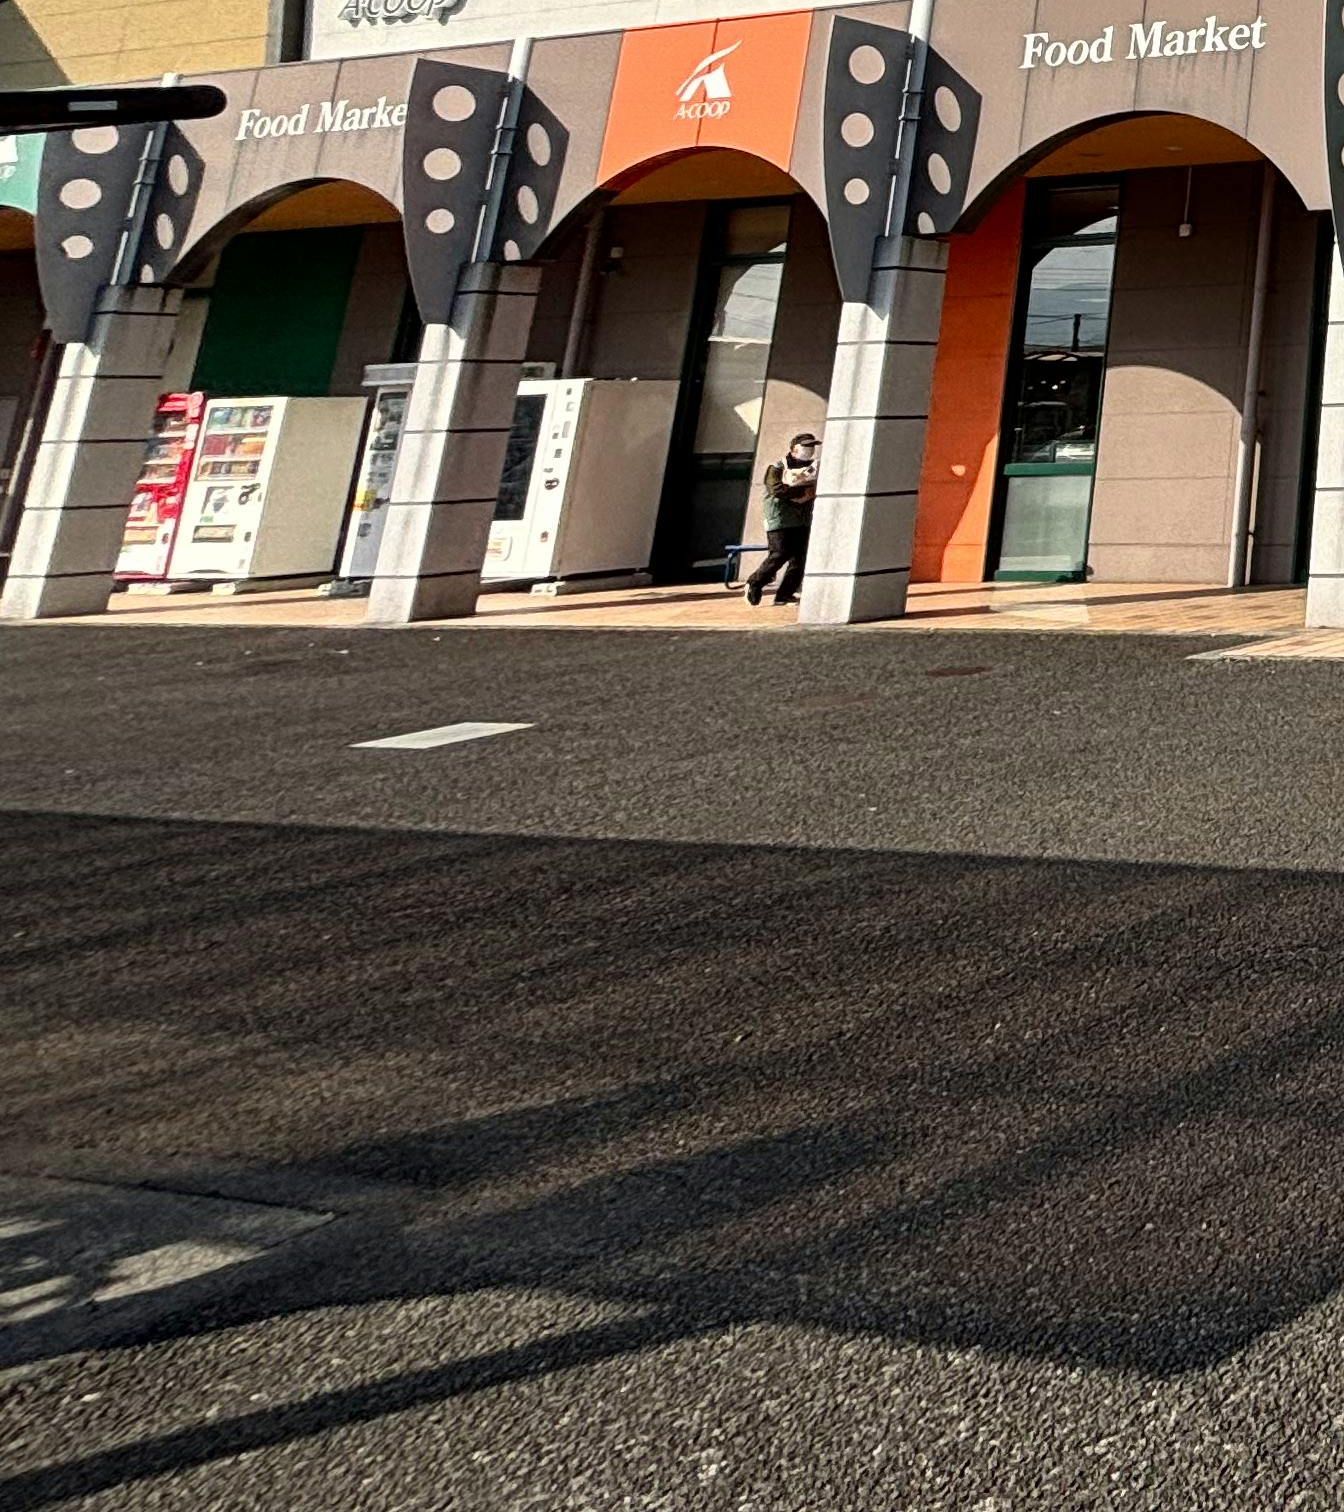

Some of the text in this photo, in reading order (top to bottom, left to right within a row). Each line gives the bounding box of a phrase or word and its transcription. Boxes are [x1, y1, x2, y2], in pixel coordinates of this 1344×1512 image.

[1018, 15, 1268, 69] Food Market
[234, 95, 408, 141] Food Marke
